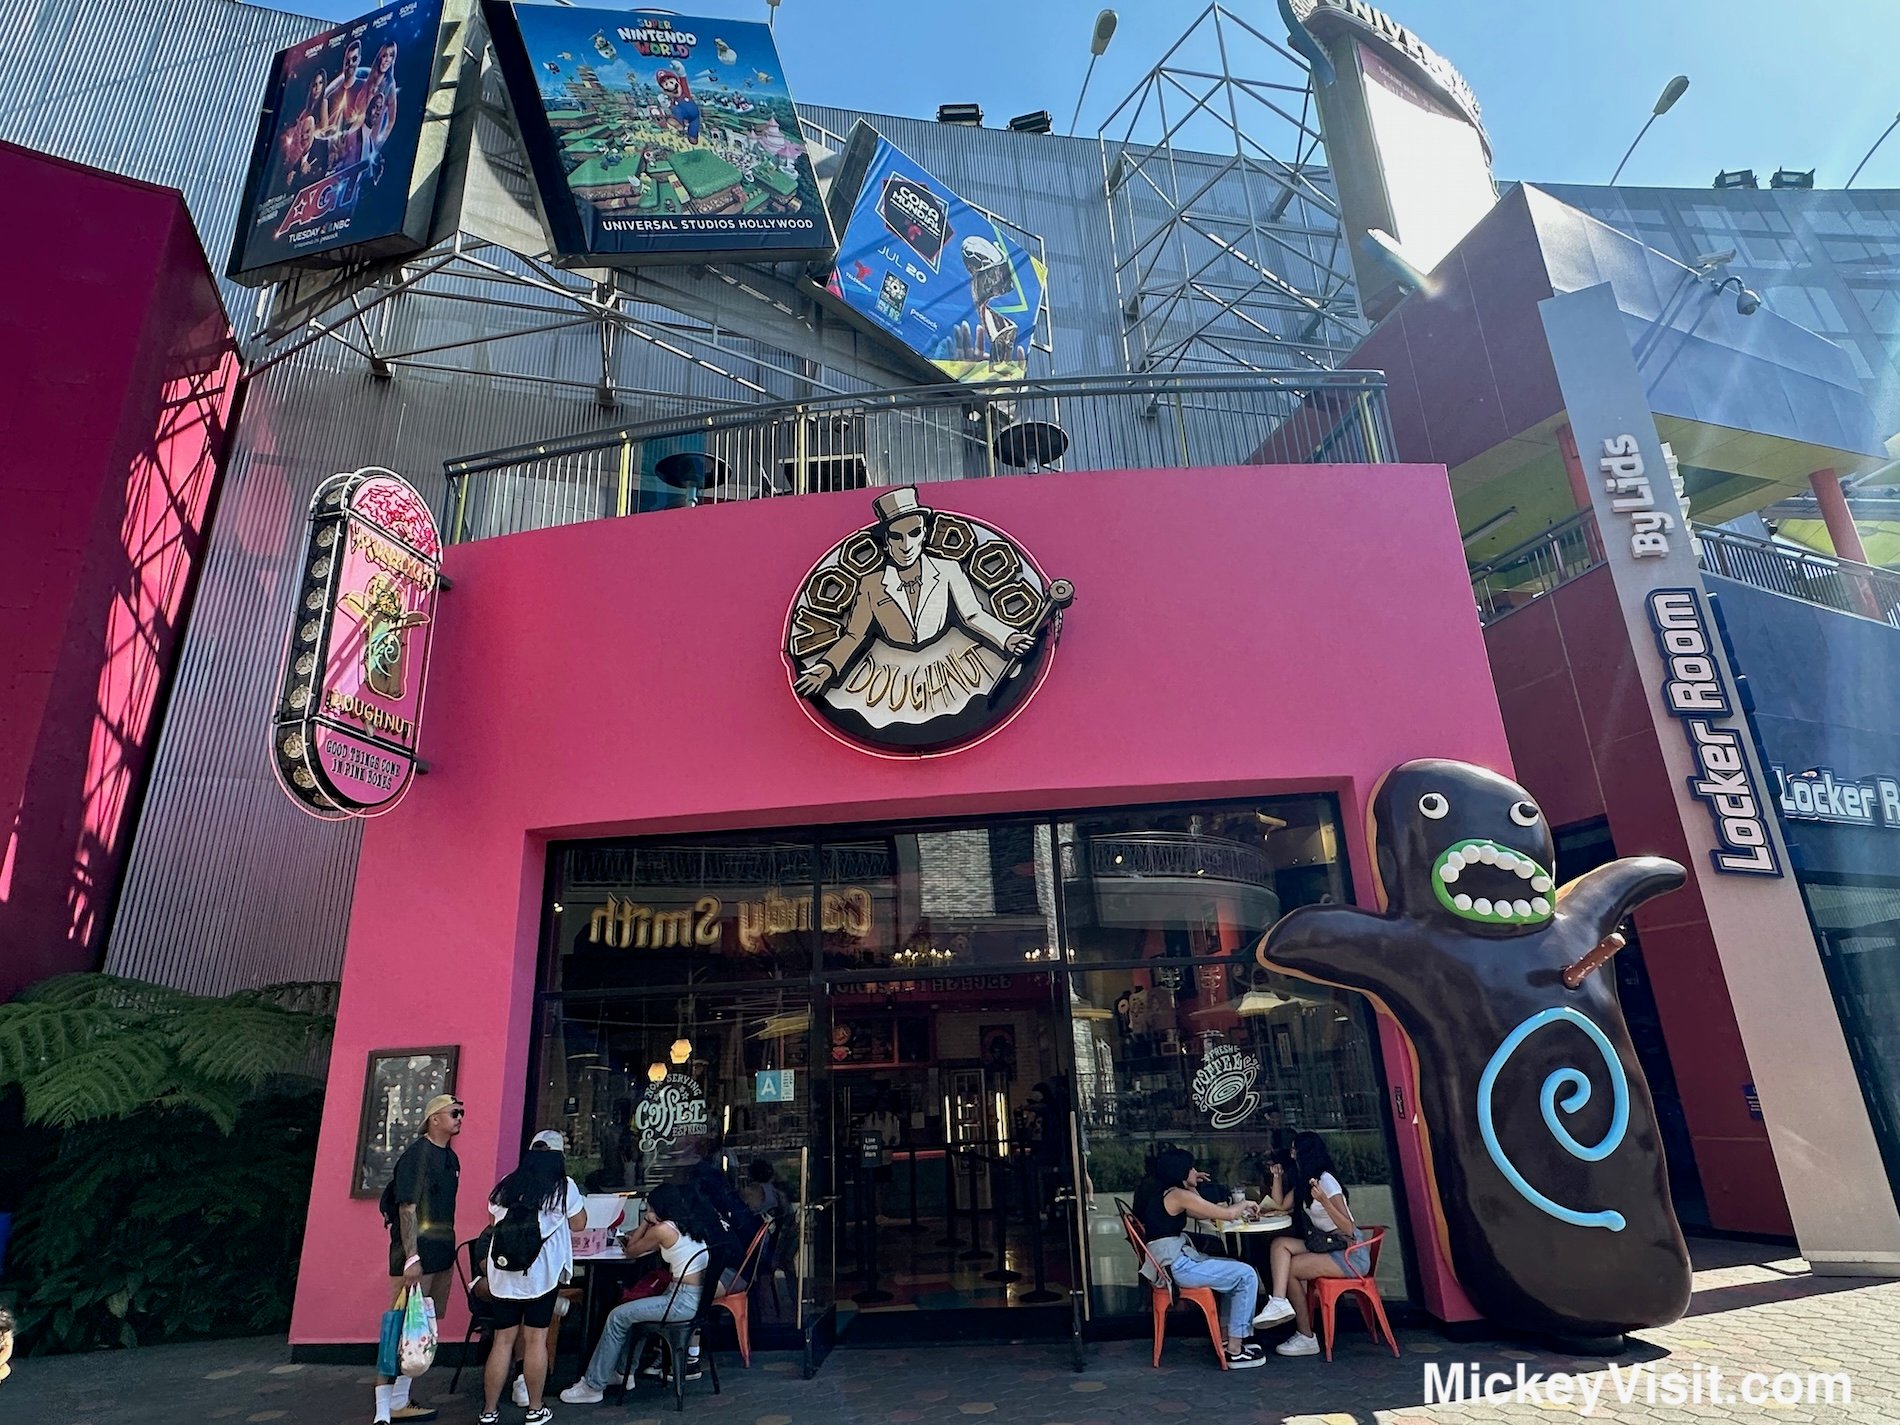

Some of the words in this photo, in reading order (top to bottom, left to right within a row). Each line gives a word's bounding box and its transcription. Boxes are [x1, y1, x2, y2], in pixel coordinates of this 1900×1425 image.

[617, 27, 697, 46] NINTENDO
[637, 18, 672, 30] SUPER
[635, 41, 689, 58] WORLD
[892, 190, 941, 234] MUNDIAL
[900, 186, 940, 222] COPA
[288, 226, 320, 243] TUESDAY
[332, 218, 351, 231] NBC
[602, 220, 678, 231] UNIVERSAL
[680, 219, 735, 230] STUDIOS
[738, 219, 814, 229] HOLLYWOOD
[877, 246, 902, 269] JUL
[905, 262, 927, 284] 20
[1600, 434, 1655, 512] Lids
[1630, 511, 1675, 559] By
[790, 513, 1043, 656] VOODOO
[1652, 592, 1724, 711] Room
[845, 643, 995, 713] DOUGHNUT
[326, 739, 348, 759] GOOD
[349, 746, 380, 770] THINGS
[381, 759, 401, 778] COME
[331, 757, 343, 774] IN
[344, 762, 365, 781] PINK
[367, 769, 392, 791] BOXES
[1691, 720, 1778, 874] Locker
[1774, 766, 1874, 819] Locker
[666, 1073, 702, 1097] SERVING
[760, 1076, 777, 1096] A
